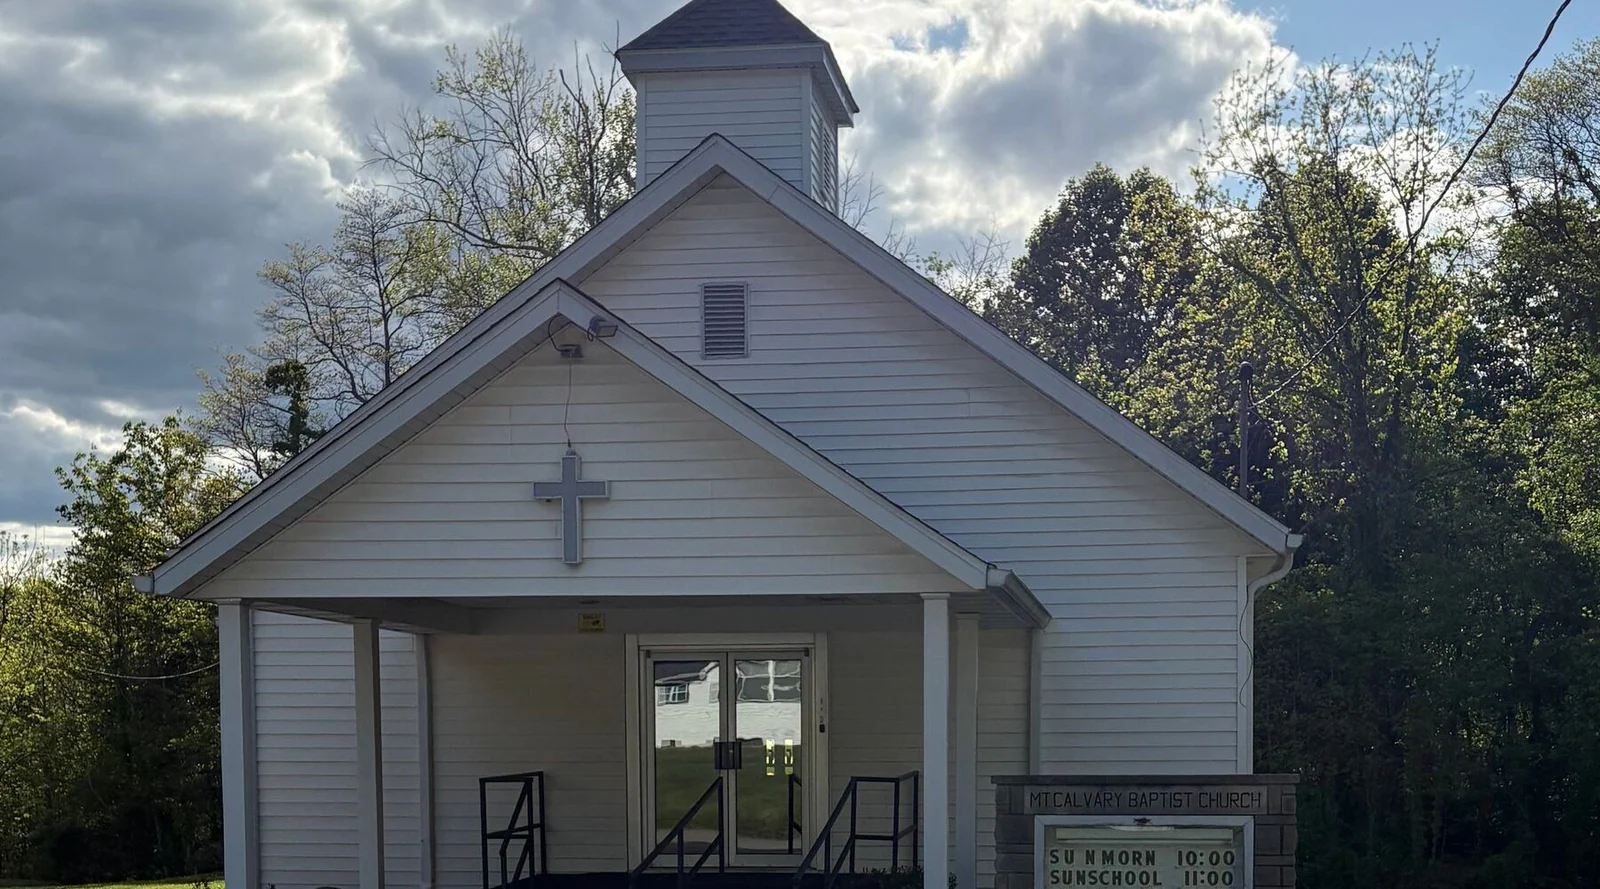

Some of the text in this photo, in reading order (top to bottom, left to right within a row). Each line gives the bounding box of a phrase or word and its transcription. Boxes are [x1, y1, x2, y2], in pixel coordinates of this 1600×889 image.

[1029, 792, 1261, 808] MT CALVARY BAPTIST CHURCH
[1177, 850, 1235, 866] 10:00
[1184, 870, 1234, 887] 11:00
